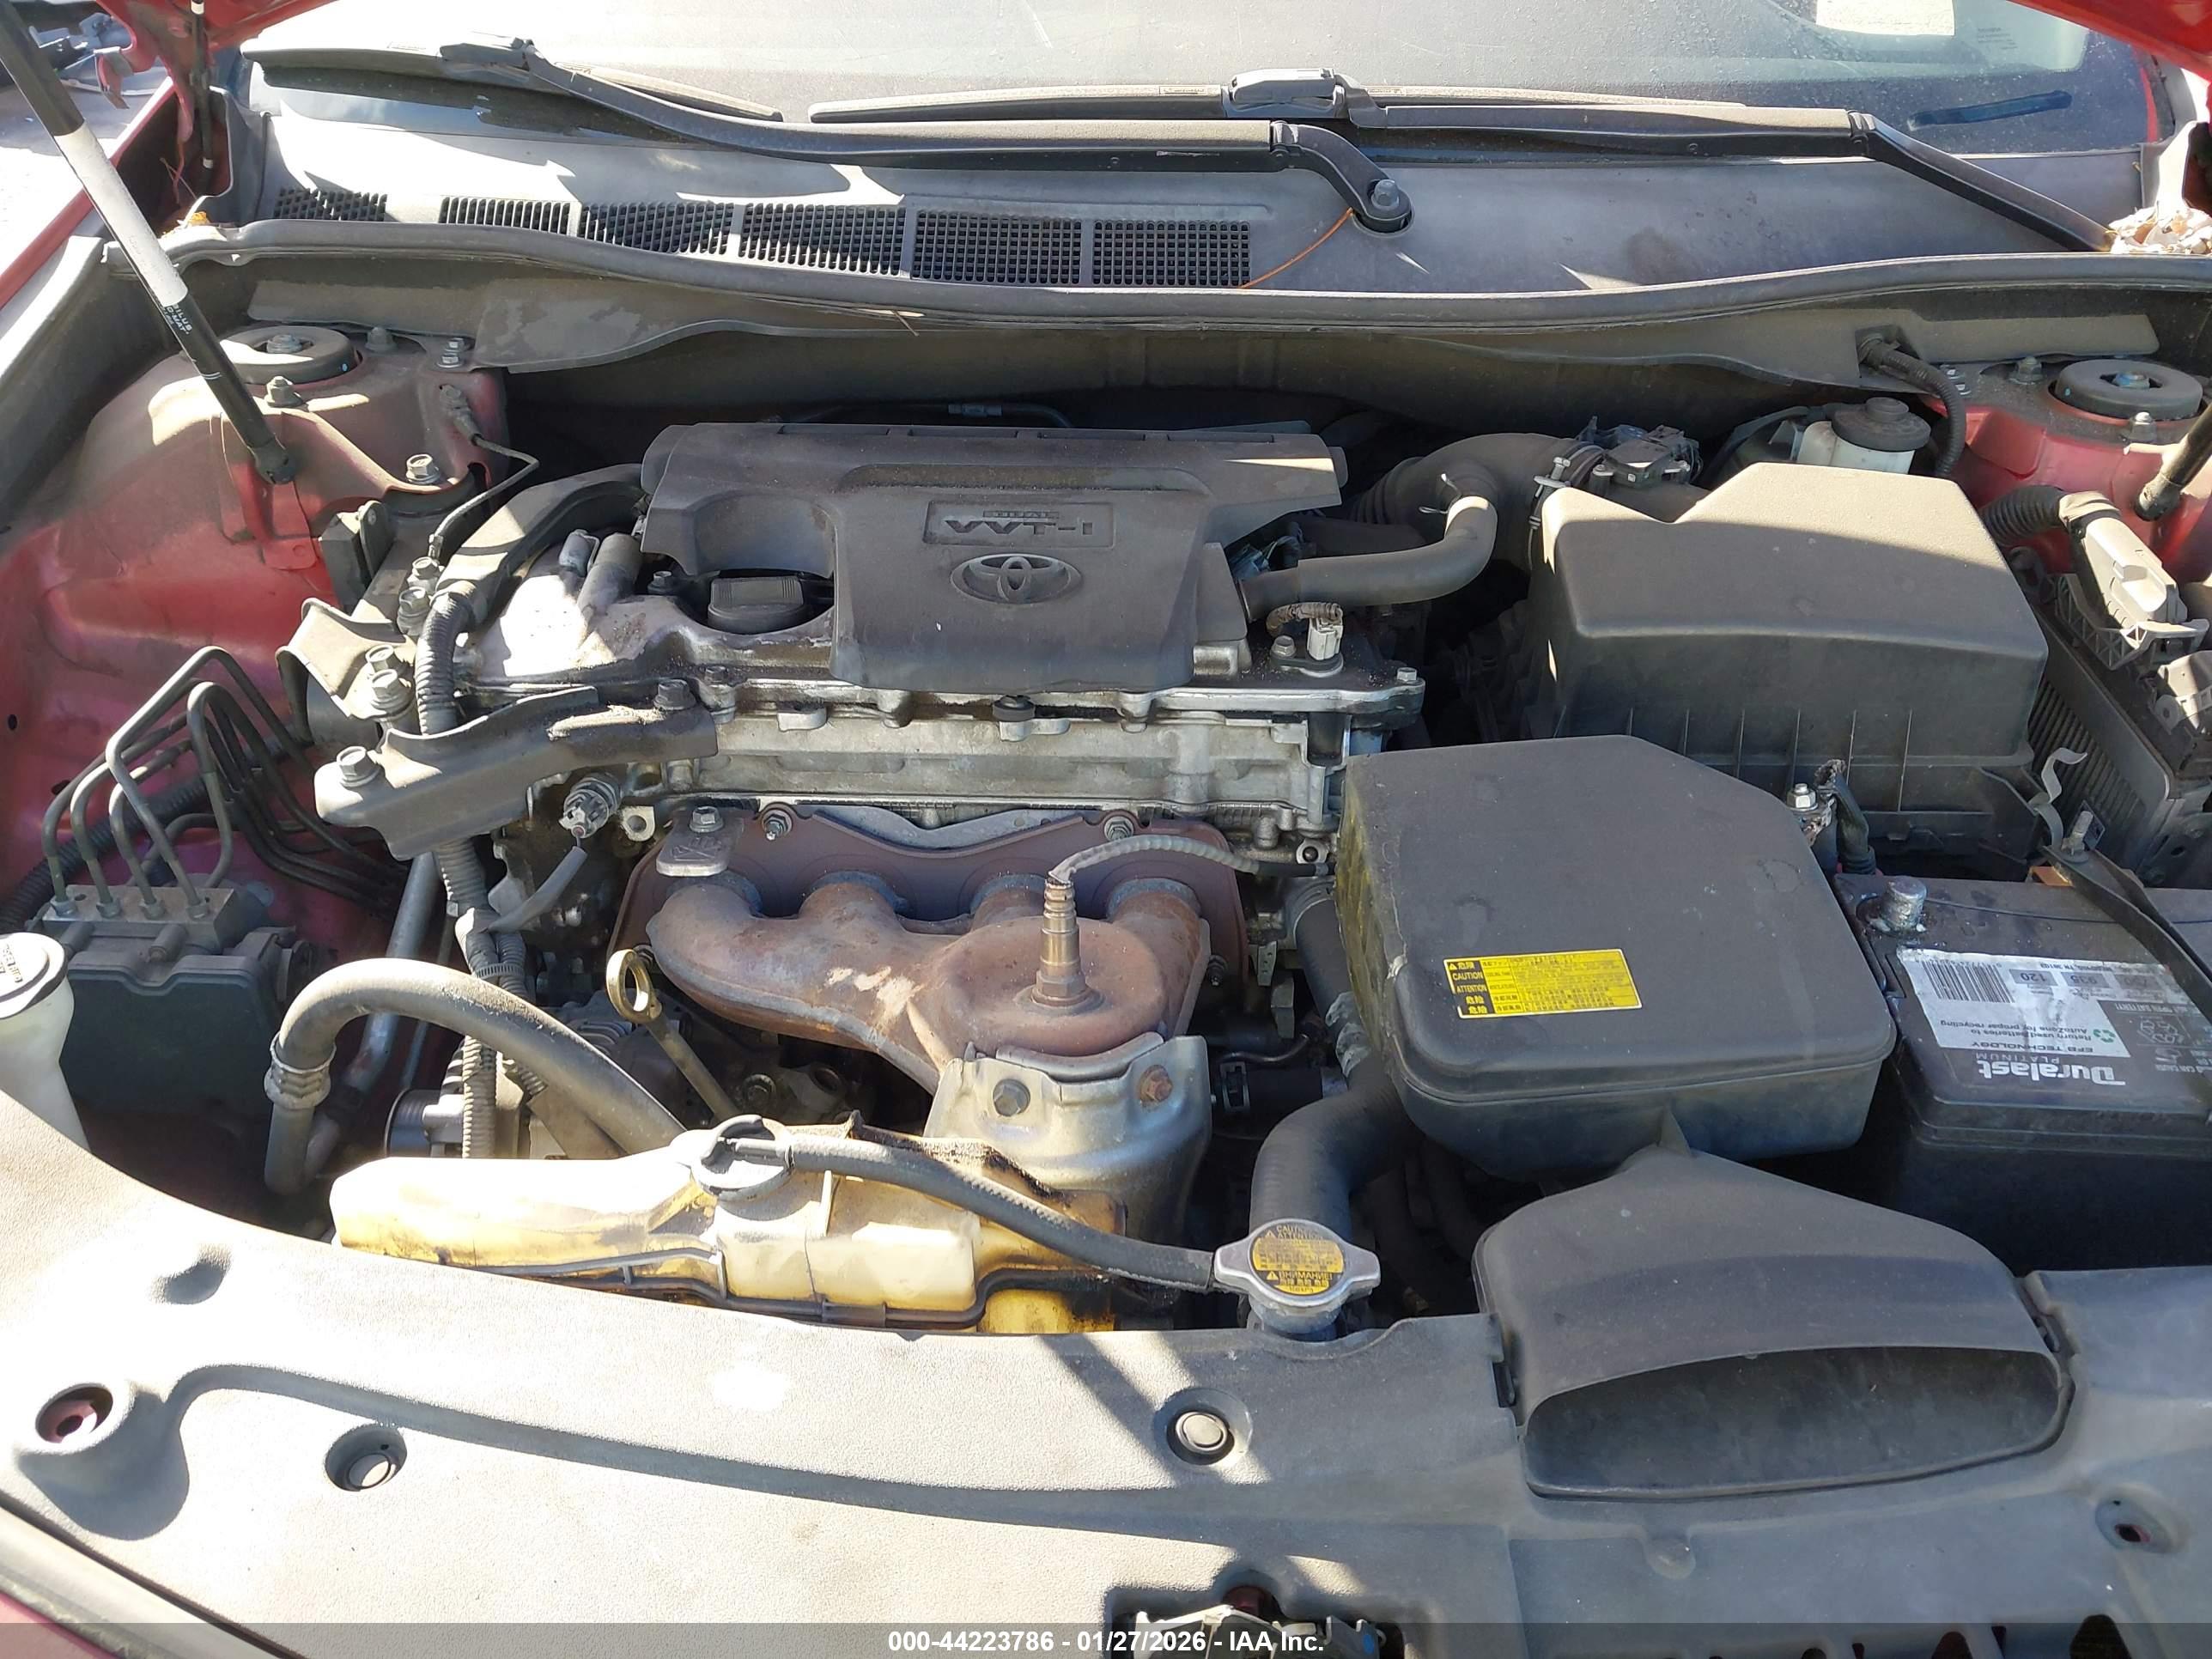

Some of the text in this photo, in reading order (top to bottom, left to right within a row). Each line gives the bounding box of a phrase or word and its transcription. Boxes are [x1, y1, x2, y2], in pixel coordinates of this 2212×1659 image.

[1452, 971, 1484, 981] CAUTION
[2021, 971, 2047, 982] 120
[1456, 984, 1487, 994] ATTENTION
[1940, 1019, 1985, 1030] recycling
[1987, 1021, 2021, 1031] proper
[2039, 1025, 2087, 1035] AutoZone
[2029, 1031, 2055, 1040] used
[2057, 1032, 2091, 1041] Return
[1971, 1041, 2063, 1052] TECHNOLOGY
[1975, 1053, 2061, 1064] PLATINUM
[1978, 1060, 2126, 1085] Duralast
